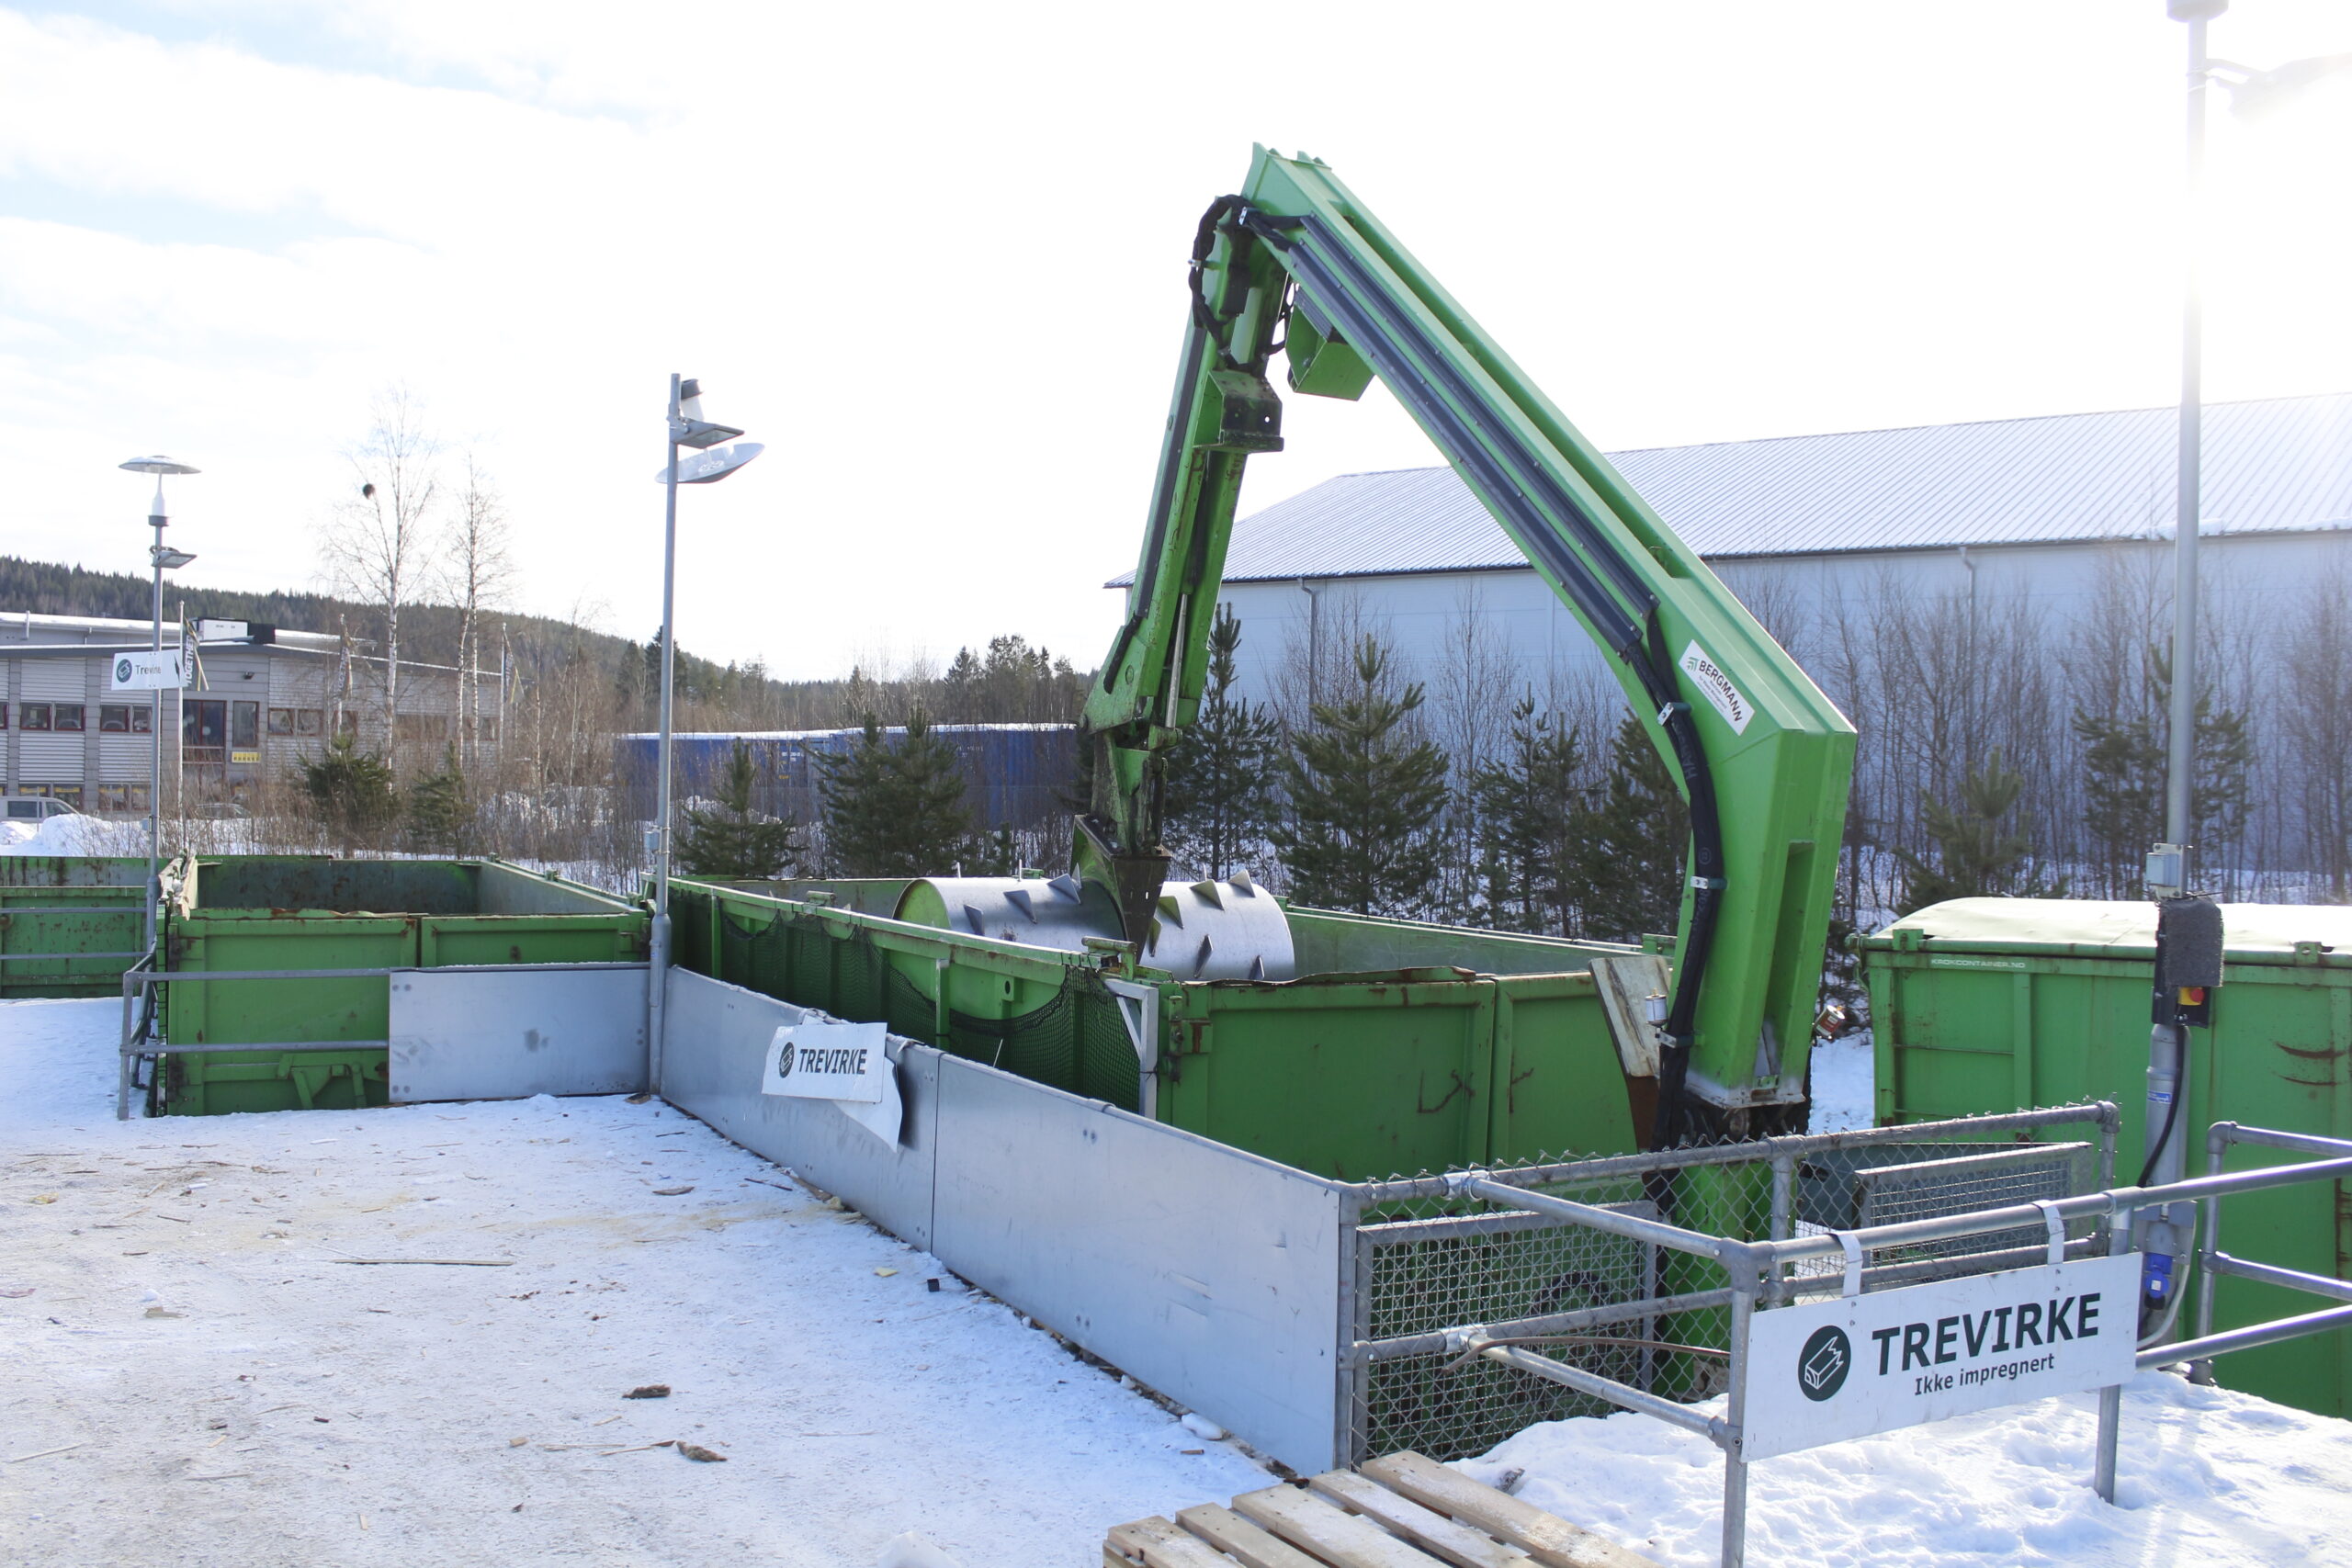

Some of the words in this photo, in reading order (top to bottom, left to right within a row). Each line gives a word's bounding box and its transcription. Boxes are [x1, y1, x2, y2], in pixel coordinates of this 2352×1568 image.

[1699, 660, 1743, 722] BERGMANN
[798, 1048, 867, 1074] TREVIRKE
[1871, 1292, 2100, 1376] TREVIRKE
[1915, 1374, 1953, 1395] Ikke
[1959, 1353, 2054, 1386] impregnert
